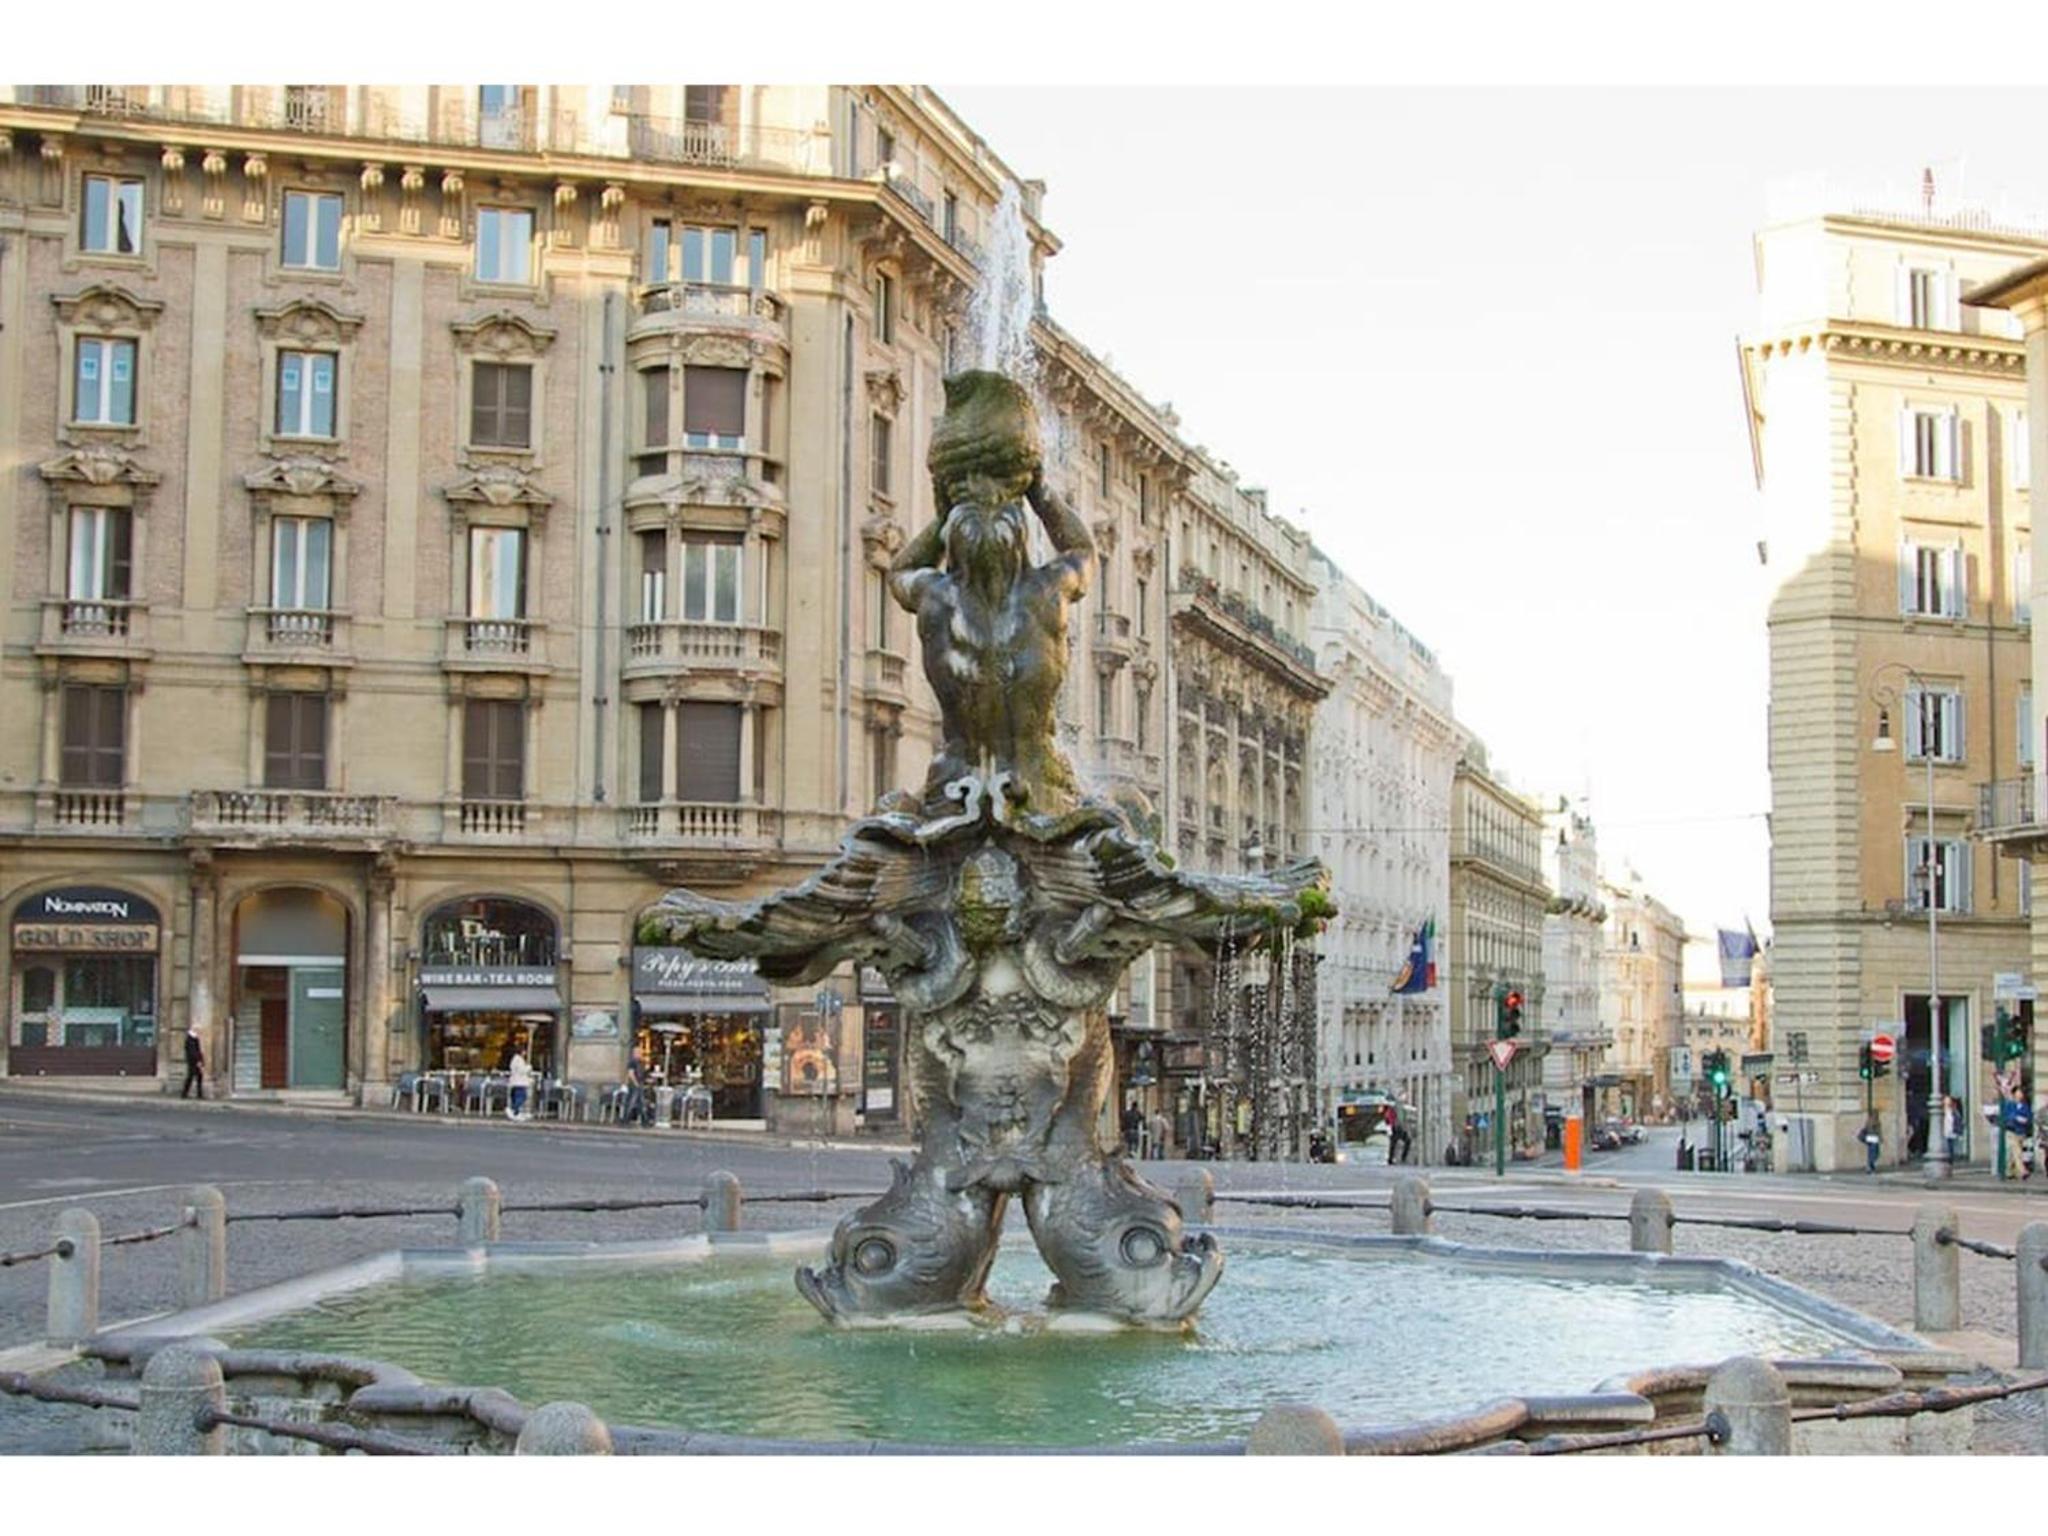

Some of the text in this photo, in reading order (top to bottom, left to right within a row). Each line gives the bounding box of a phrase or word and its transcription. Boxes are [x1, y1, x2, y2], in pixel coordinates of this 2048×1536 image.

[18, 929, 149, 947] GOLD SHOP
[456, 973, 481, 985] BAR
[489, 973, 515, 985] TEA
[517, 973, 555, 985] ROOM
